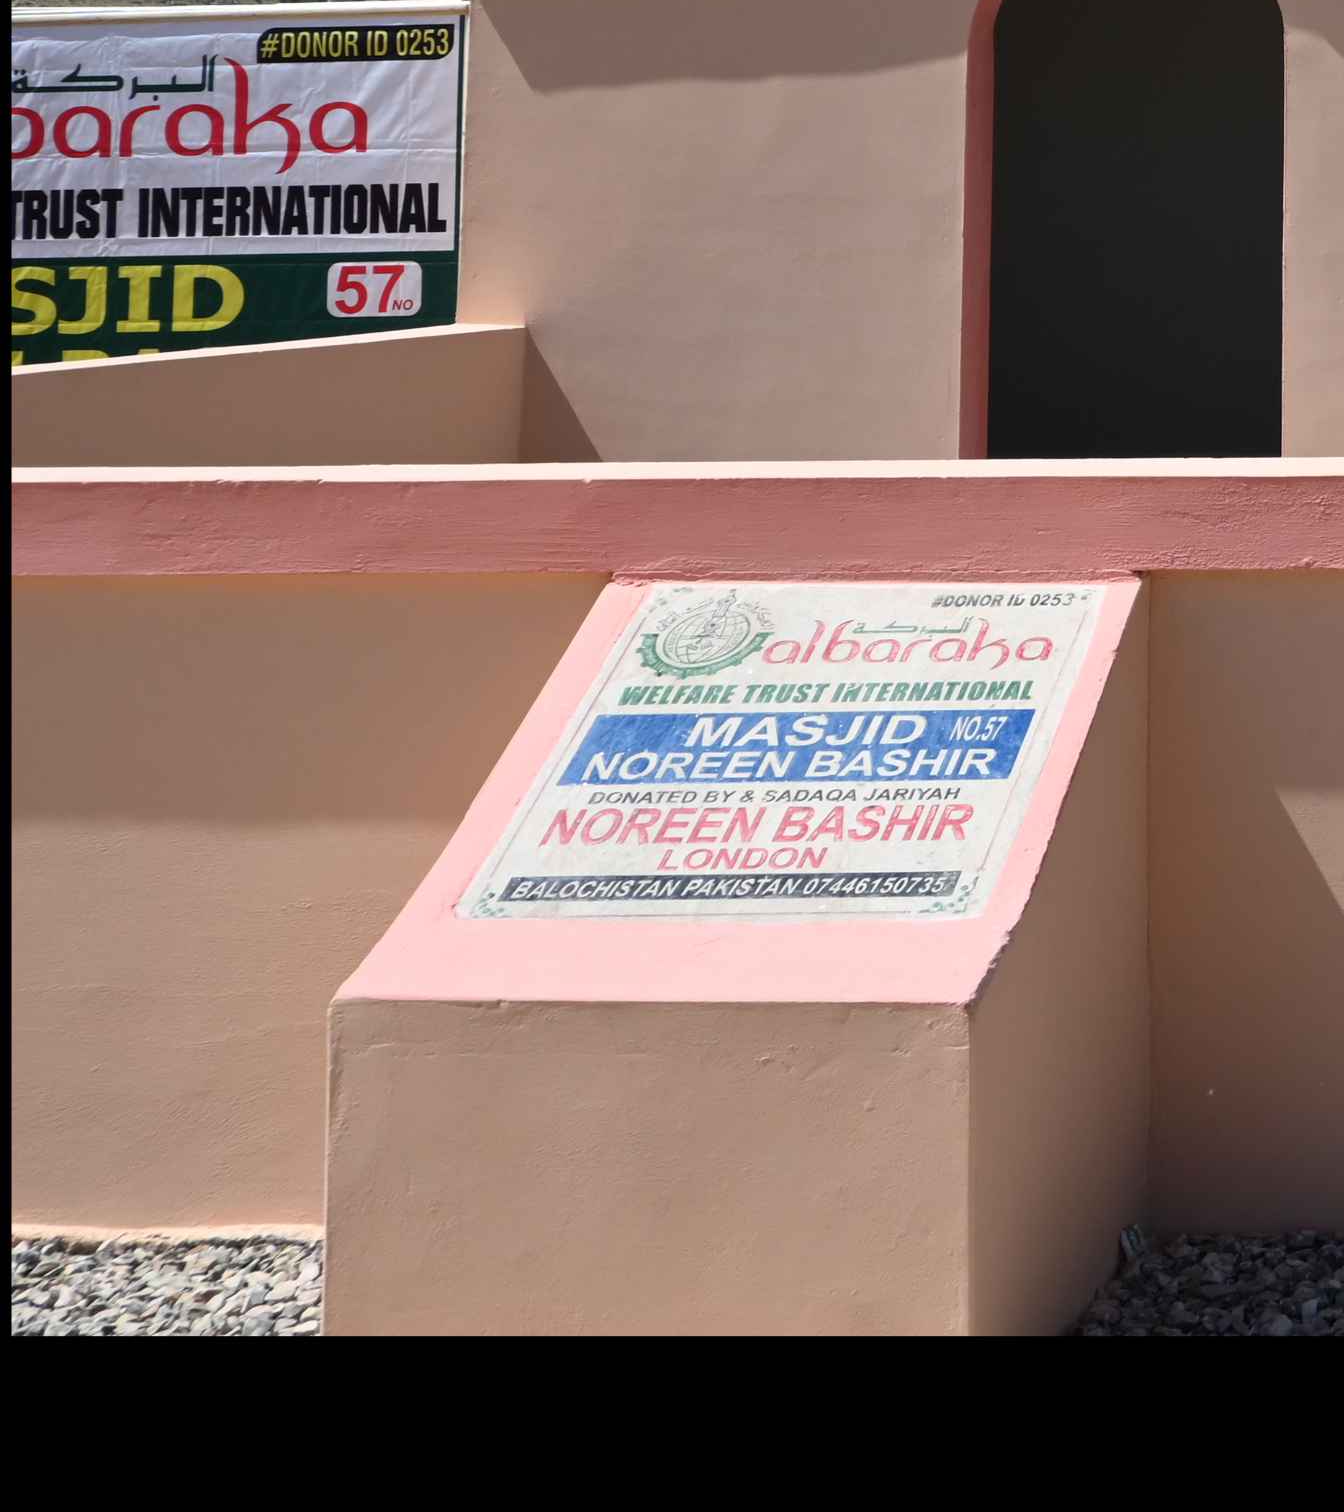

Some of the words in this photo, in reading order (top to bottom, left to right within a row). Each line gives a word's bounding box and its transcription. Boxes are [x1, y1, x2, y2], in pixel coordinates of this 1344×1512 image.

[260, 31, 358, 59] #DONOR
[366, 30, 388, 57] ID
[396, 28, 449, 56] 0253
[12, 188, 124, 240] TRUST
[138, 183, 447, 238] INTERNATIONAL
[335, 266, 405, 314] 57
[392, 299, 413, 311] NO
[931, 594, 1002, 608] #DONOR
[1029, 593, 1076, 607] 0253
[762, 618, 1054, 671] albaraka
[617, 684, 736, 706] WELFARE
[742, 683, 830, 704] TRUST
[831, 680, 1034, 704] INTERNATIONAL
[683, 713, 928, 747] MASJID
[949, 714, 1009, 741] NO.57
[580, 750, 796, 782] NOREEN
[803, 747, 998, 778] BASHIR
[588, 790, 697, 805] DONATED
[702, 789, 736, 803] BY
[740, 789, 755, 803] &
[762, 789, 858, 803] SADAQA
[863, 787, 961, 802] JARIYAH
[538, 804, 767, 848] NOREEN
[771, 803, 975, 842] BASHIR
[656, 846, 828, 871] LONDON
[510, 879, 681, 900] BALOCHISTAN
[680, 877, 803, 897] PAKISTAN
[803, 875, 946, 895] 07446150735
